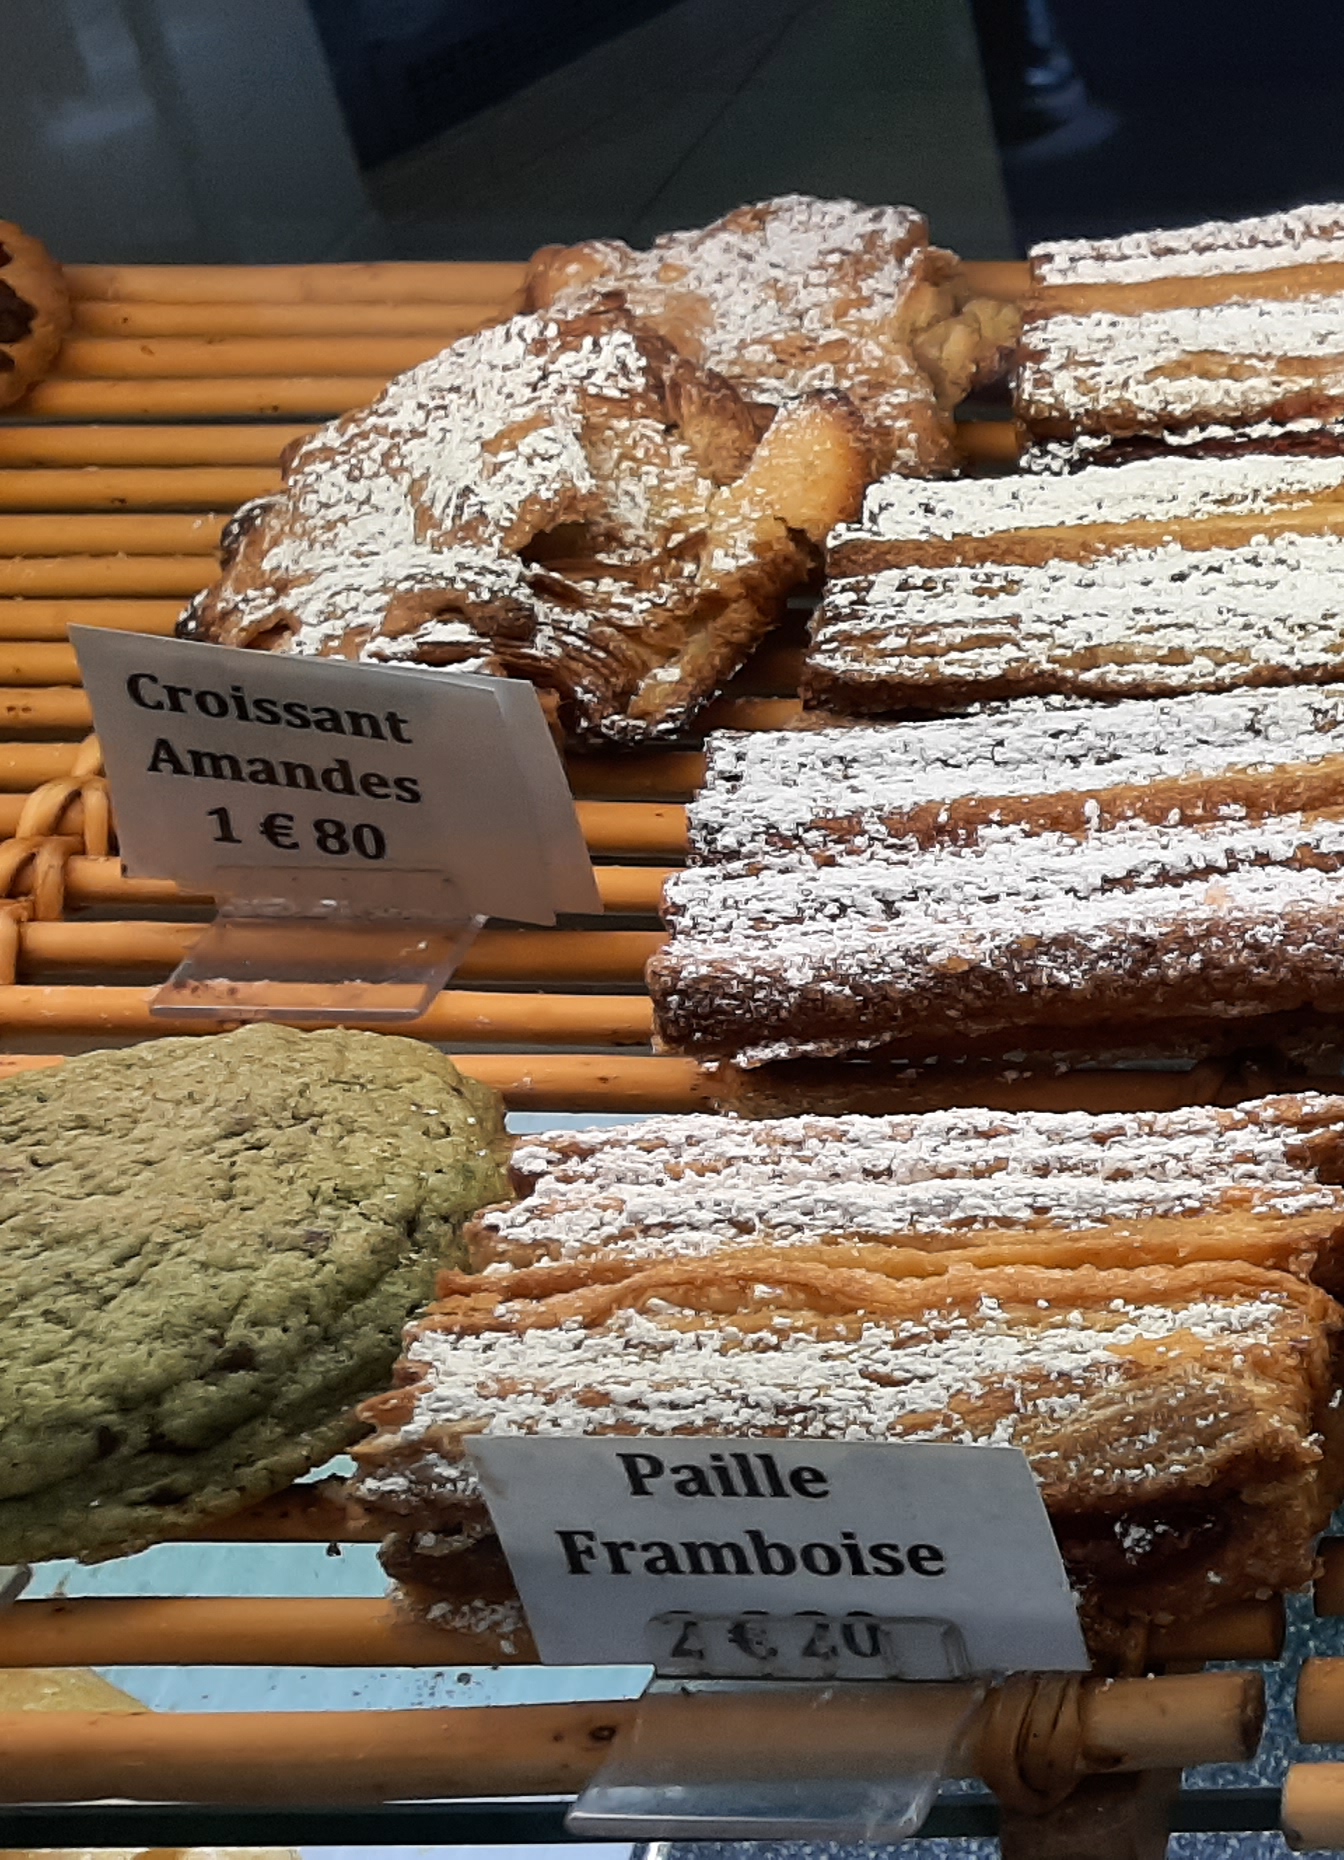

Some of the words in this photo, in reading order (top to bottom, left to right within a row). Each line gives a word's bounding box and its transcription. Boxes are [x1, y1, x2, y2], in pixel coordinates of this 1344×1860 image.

[126, 672, 413, 744] Croissant
[147, 738, 422, 803] Amandes
[207, 807, 243, 844] 1
[259, 813, 299, 851] €
[312, 818, 387, 860] 80
[617, 1452, 830, 1498] Paille
[556, 1530, 947, 1577] Framboise
